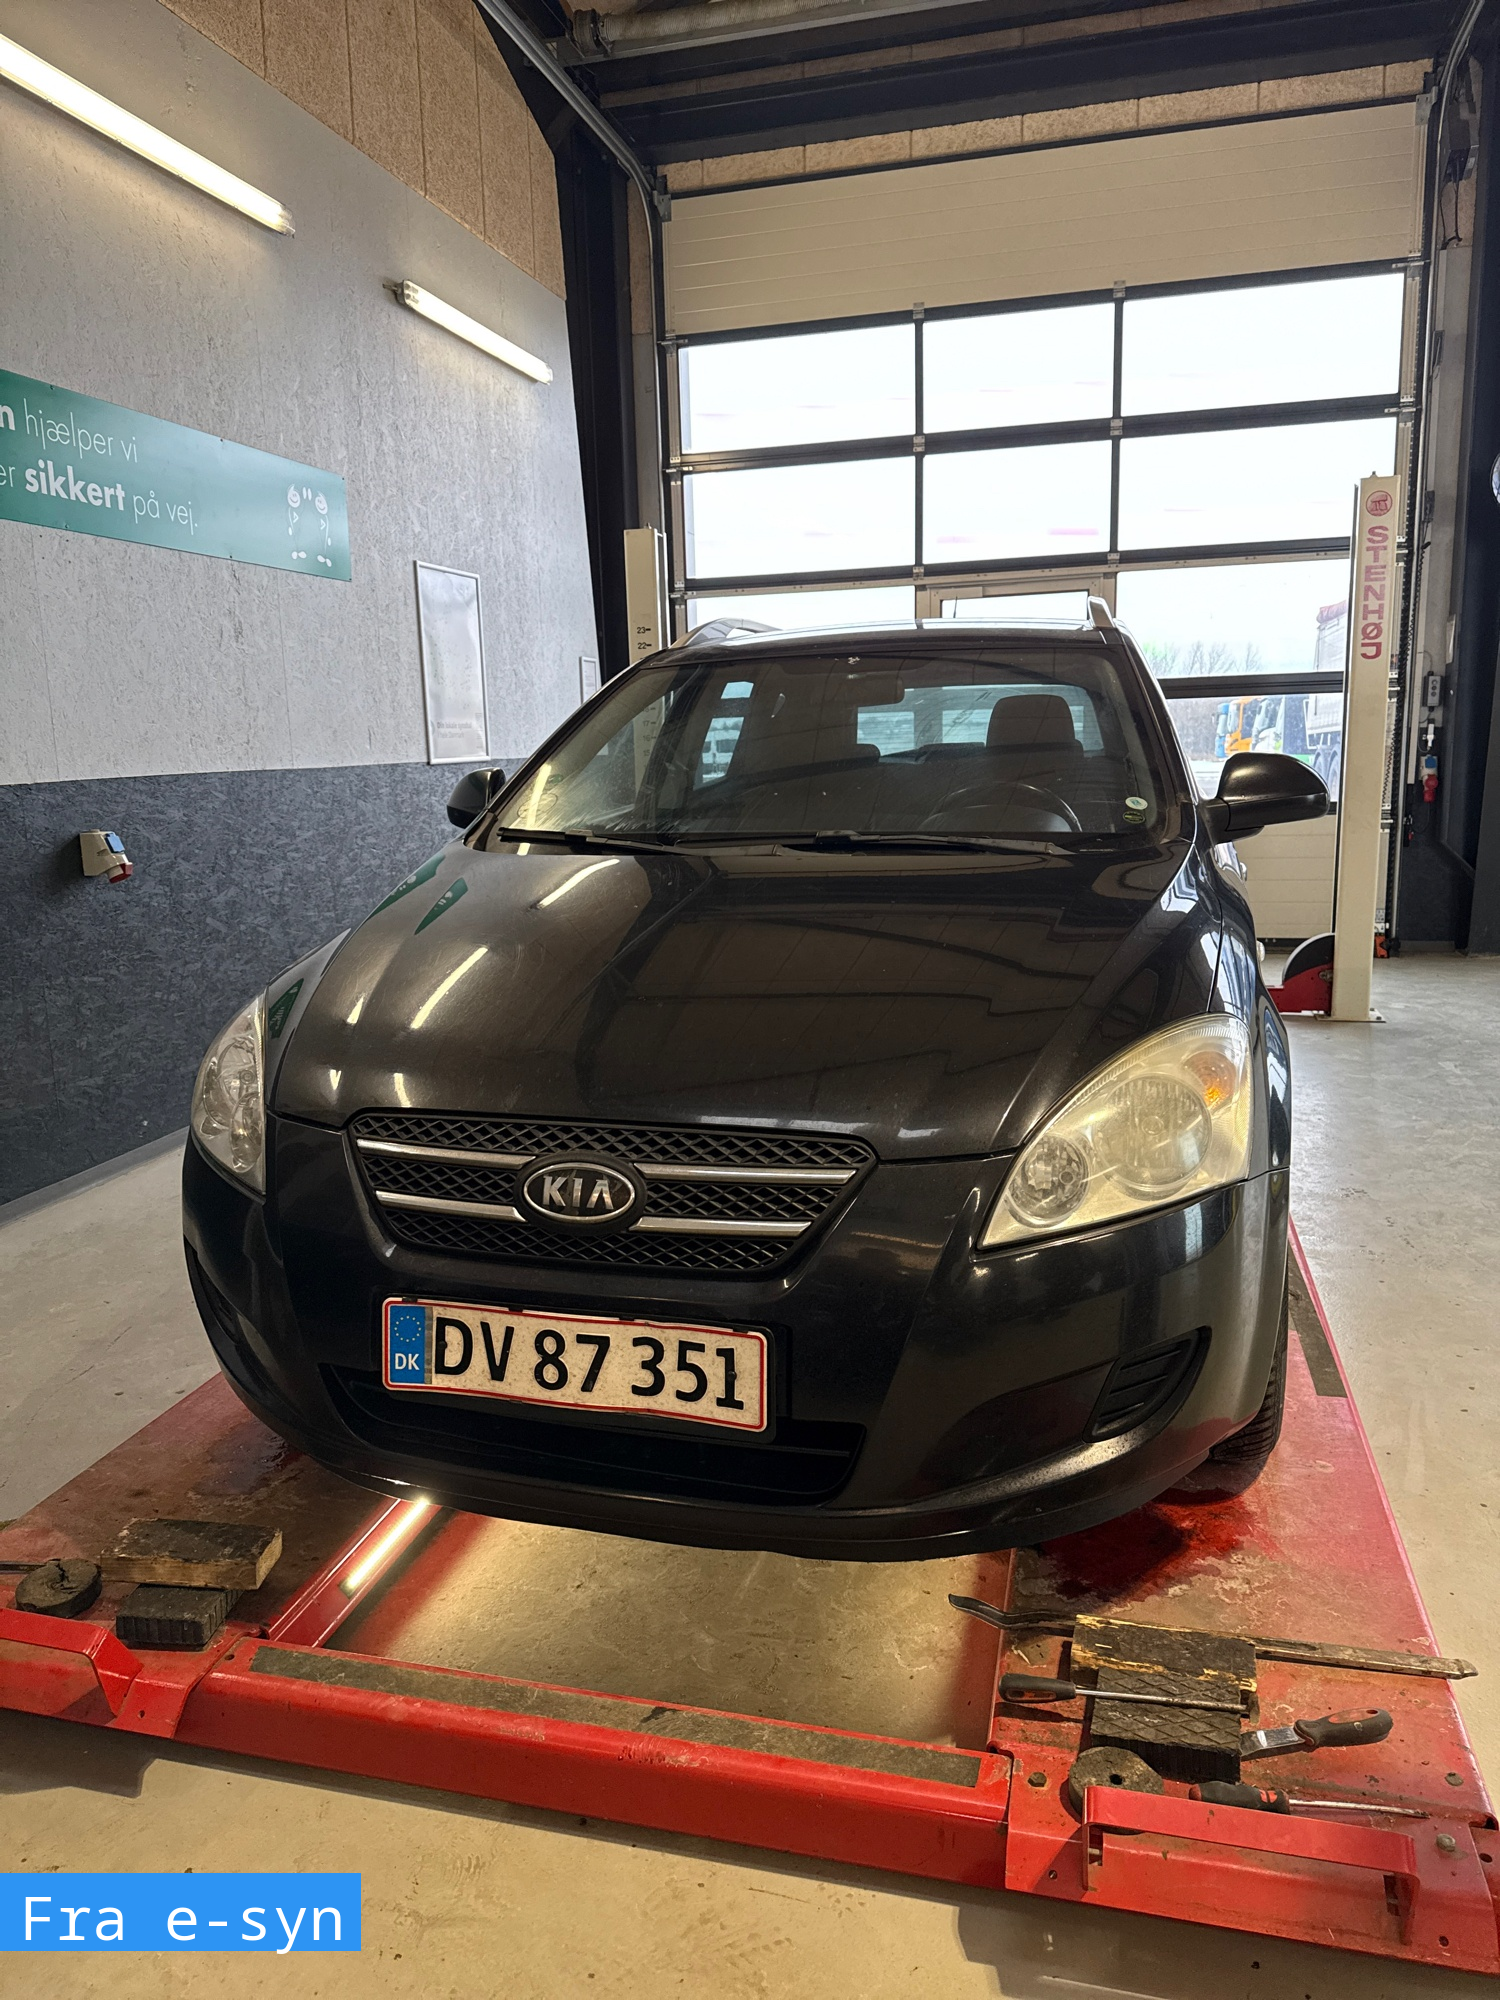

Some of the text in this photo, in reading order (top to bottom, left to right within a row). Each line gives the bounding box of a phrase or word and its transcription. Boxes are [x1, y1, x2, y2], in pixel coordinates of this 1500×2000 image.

[24, 398, 113, 459] hjælper
[121, 436, 138, 463] vi
[25, 459, 125, 511] sikkert
[133, 490, 160, 524] på
[166, 501, 198, 535] vej.
[1360, 525, 1390, 660] STENHØJ
[637, 626, 646, 634] 23
[637, 642, 647, 650] 22
[542, 1174, 614, 1210] KIA
[394, 1316, 745, 1411] DK DV 87 351
